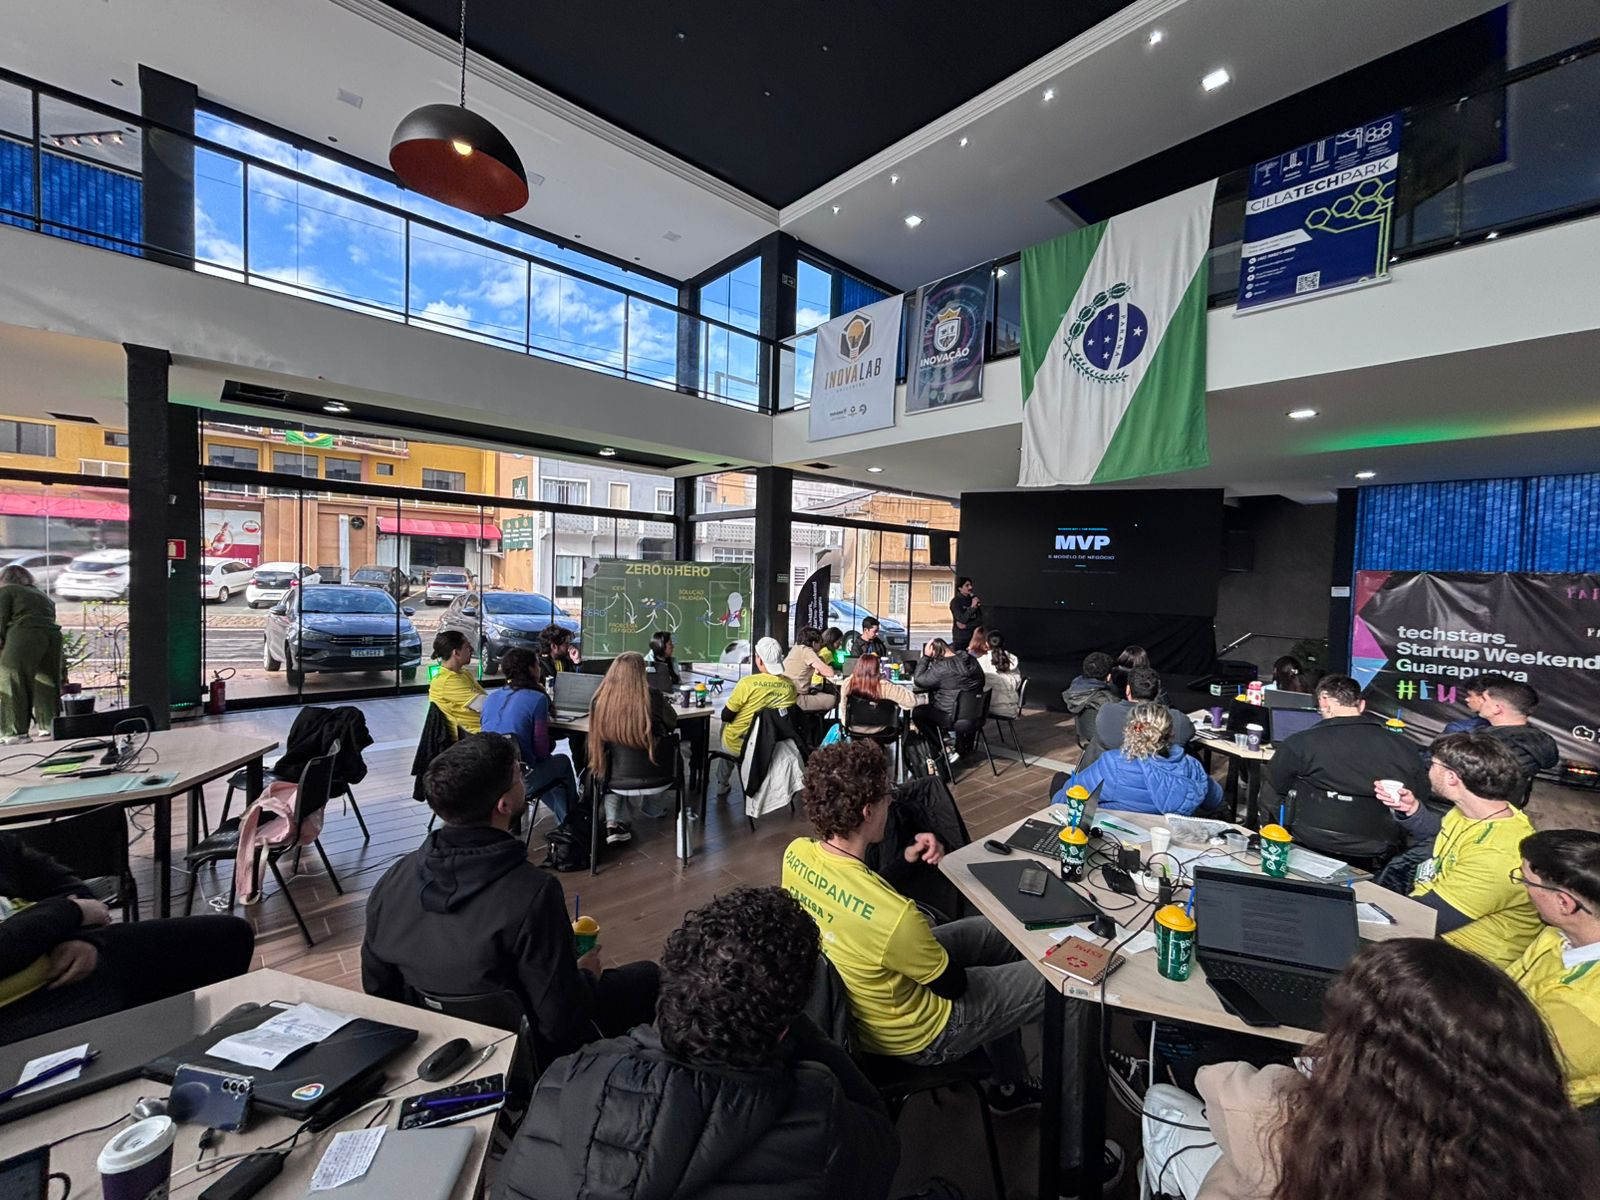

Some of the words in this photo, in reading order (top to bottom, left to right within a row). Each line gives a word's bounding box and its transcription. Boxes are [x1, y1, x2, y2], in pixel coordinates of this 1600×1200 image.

[1250, 158, 1390, 212] CILLATECHPARK
[920, 347, 970, 367] INOVAÇÃO
[824, 357, 882, 390] INOVALAB
[1055, 535, 1110, 550] MVP
[625, 563, 661, 575] ZERO
[663, 566, 673, 576] to
[674, 566, 711, 577] HERO
[1397, 625, 1517, 648] techstars_
[1396, 641, 1480, 662] Startup
[1483, 648, 1600, 670] Weekend
[785, 850, 875, 921] PARTICIPANTE
[827, 912, 834, 924] 7
